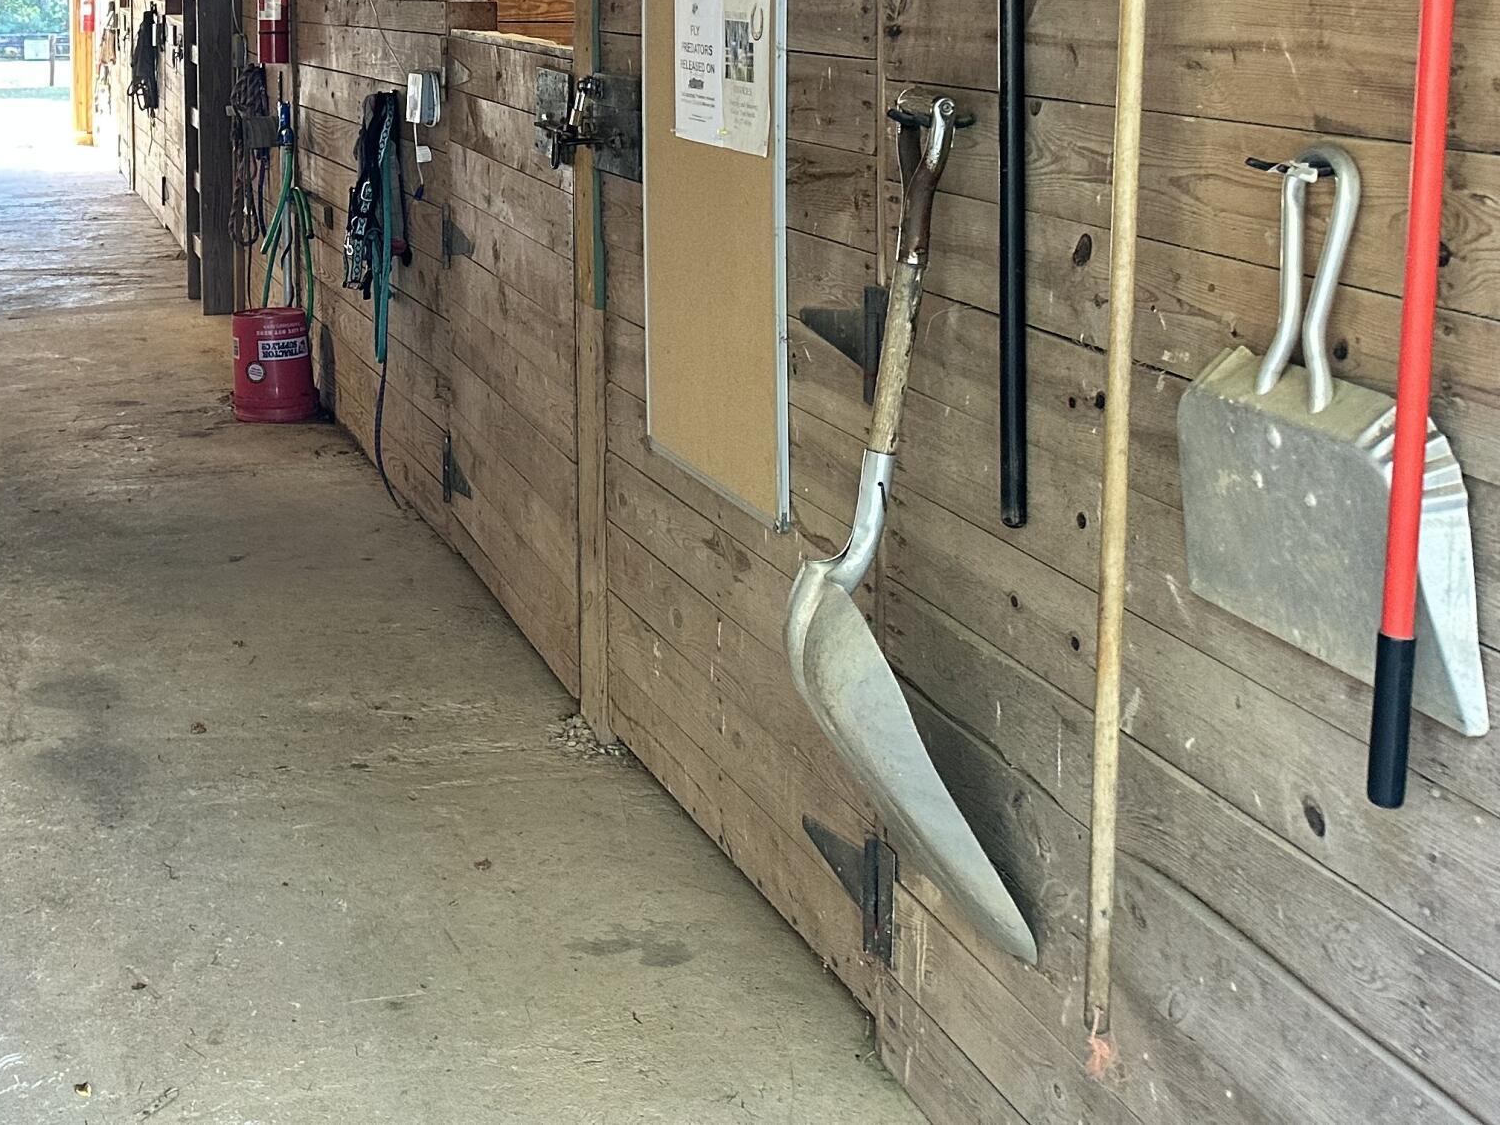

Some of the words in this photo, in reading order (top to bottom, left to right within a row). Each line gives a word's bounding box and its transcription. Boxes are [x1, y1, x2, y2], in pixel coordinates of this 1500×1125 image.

[690, 25, 700, 35] FLY
[706, 63, 715, 74] ON
[272, 341, 297, 350] SUPPLY
[262, 349, 299, 358] TRACTOR
